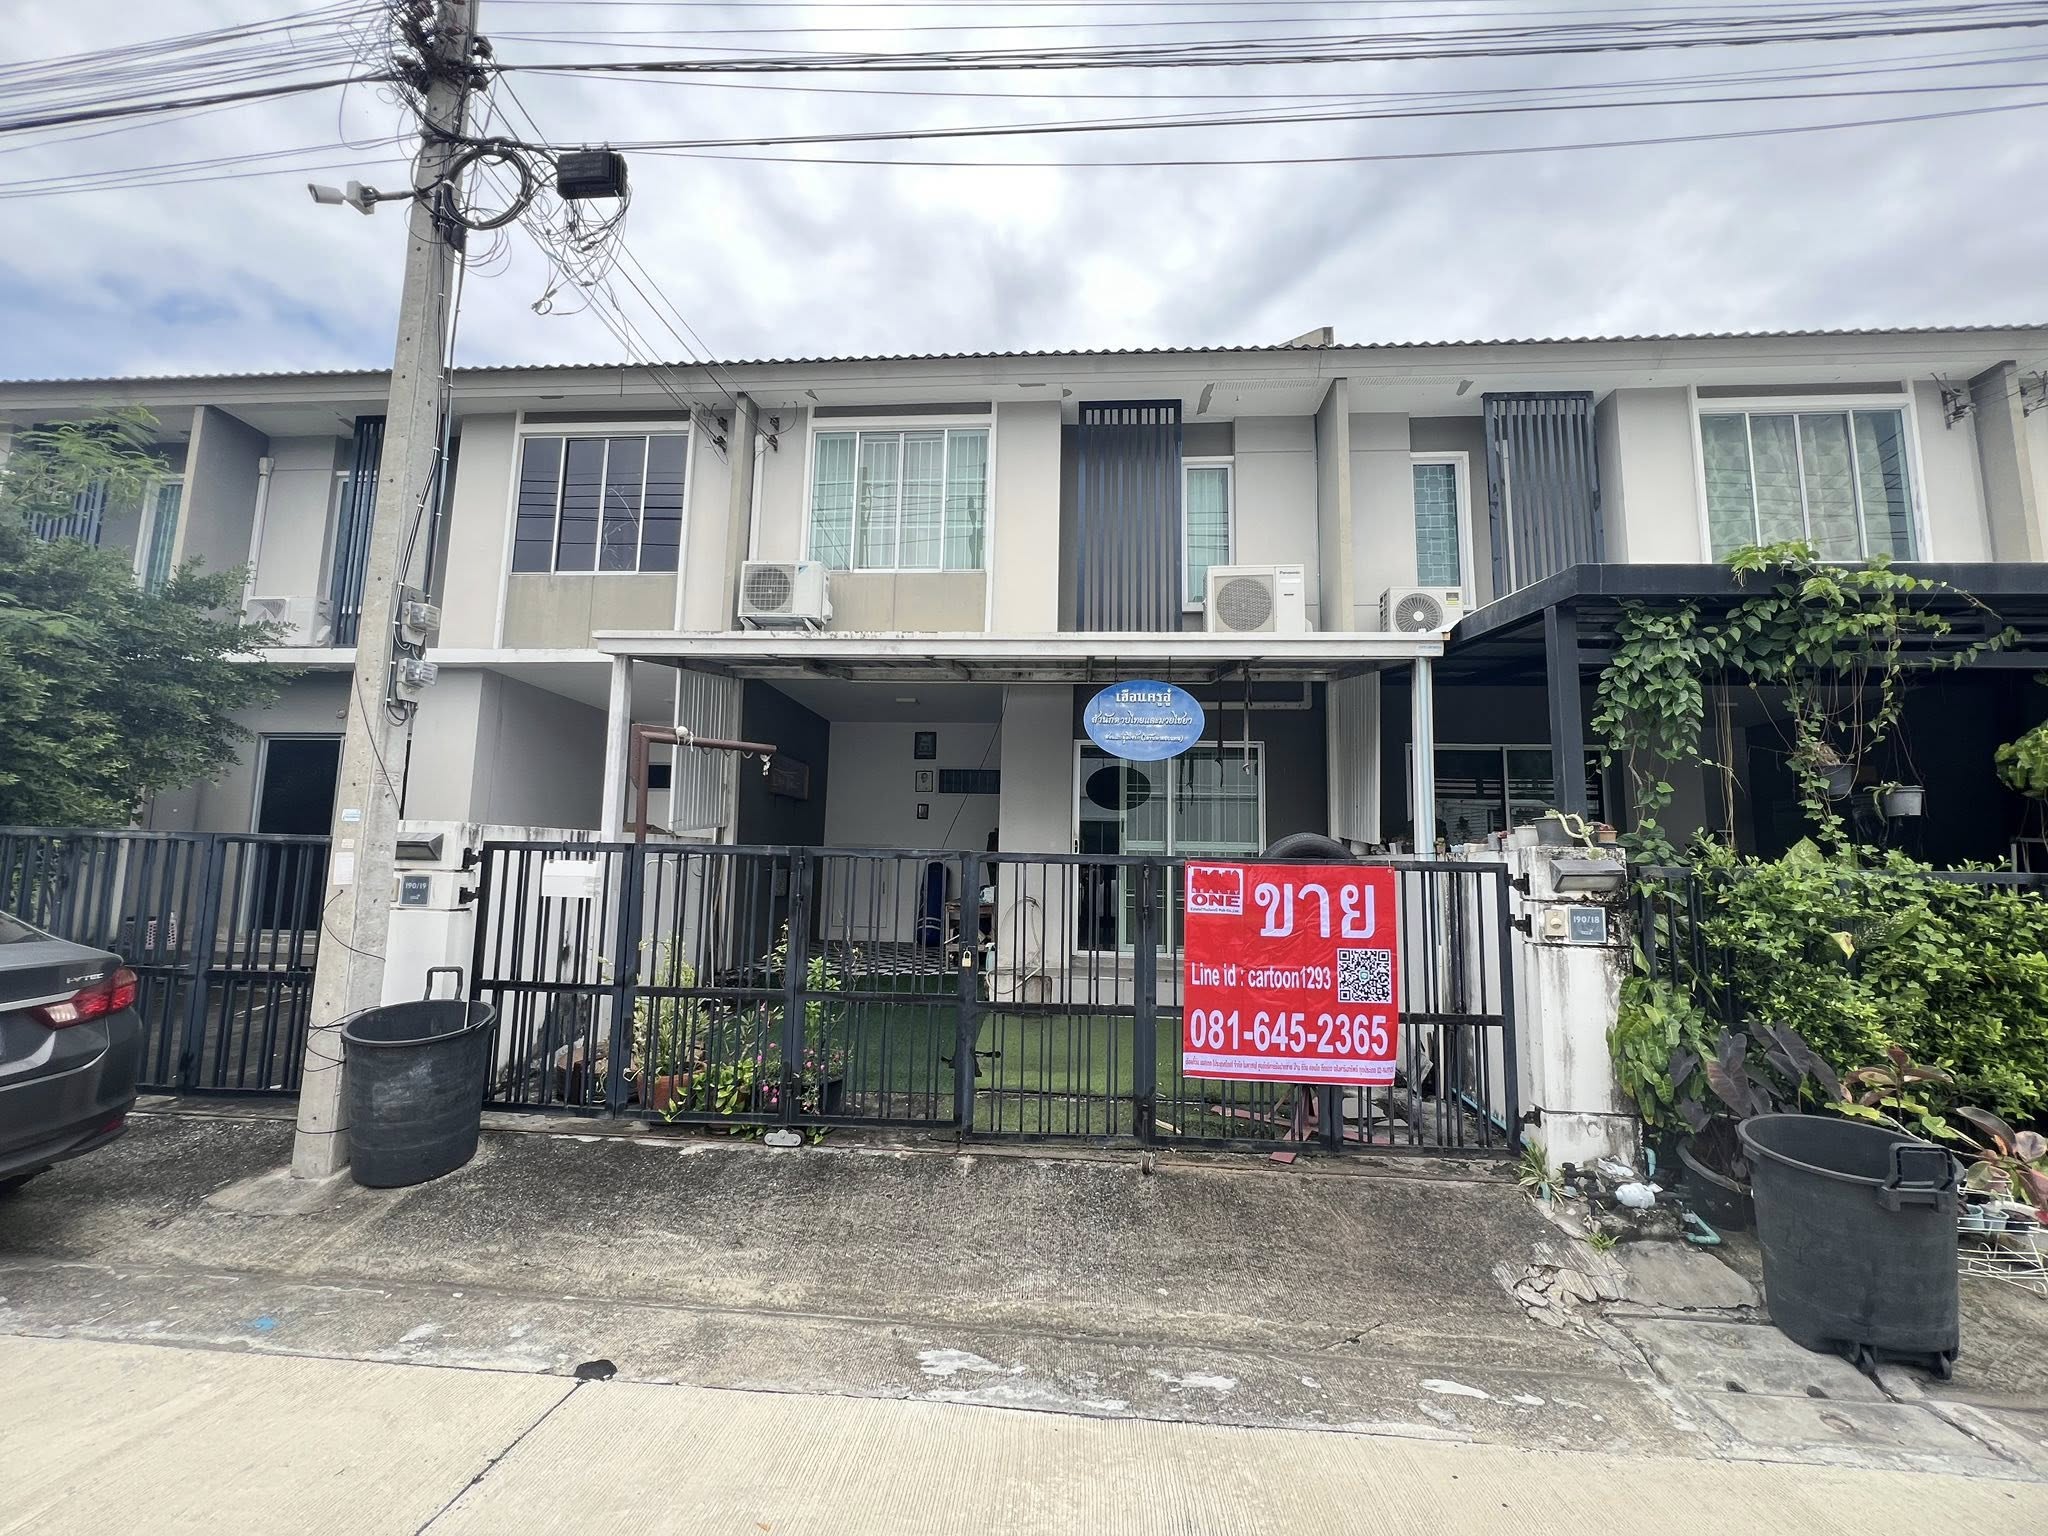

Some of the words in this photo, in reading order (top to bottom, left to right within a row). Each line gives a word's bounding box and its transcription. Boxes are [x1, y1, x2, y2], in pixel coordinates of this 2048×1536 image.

[1191, 893, 1241, 907] ONE
[1254, 882, 1375, 939] ขาย
[1573, 915, 1600, 924] 190/18
[1191, 962, 1220, 986] Line
[1223, 963, 1237, 987] id
[1247, 966, 1332, 990] cartoon1293
[1190, 1008, 1389, 1056] 081-645-2365
